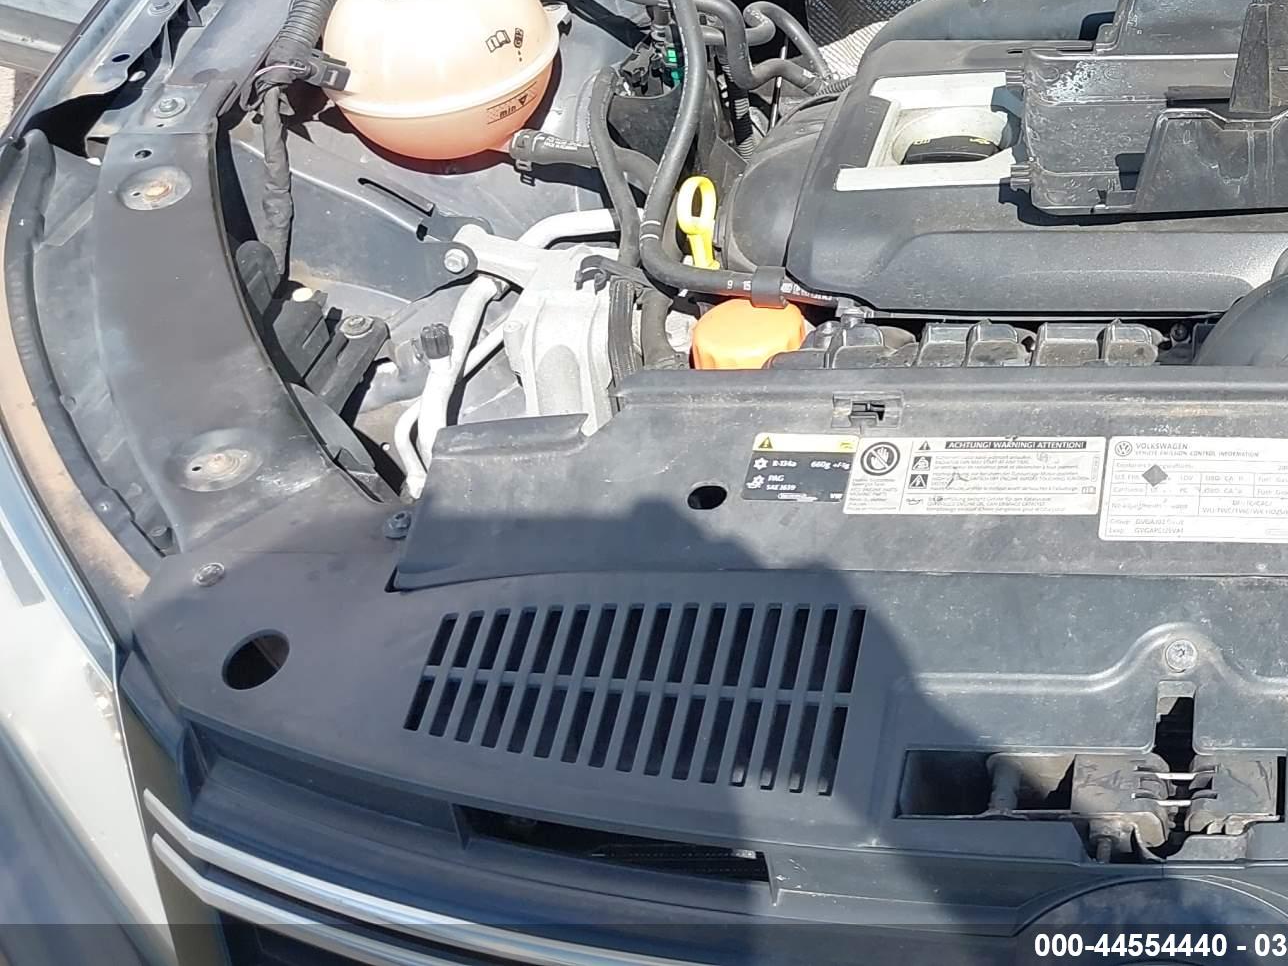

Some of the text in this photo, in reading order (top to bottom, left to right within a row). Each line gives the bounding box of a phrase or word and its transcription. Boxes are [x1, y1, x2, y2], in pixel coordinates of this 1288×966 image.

[499, 105, 517, 119] min
[948, 441, 1085, 449] ACHTUNG! WARNING! ATTENTION!
[1135, 442, 1188, 450] VOLKSWAGEN
[767, 474, 785, 482] PAG
